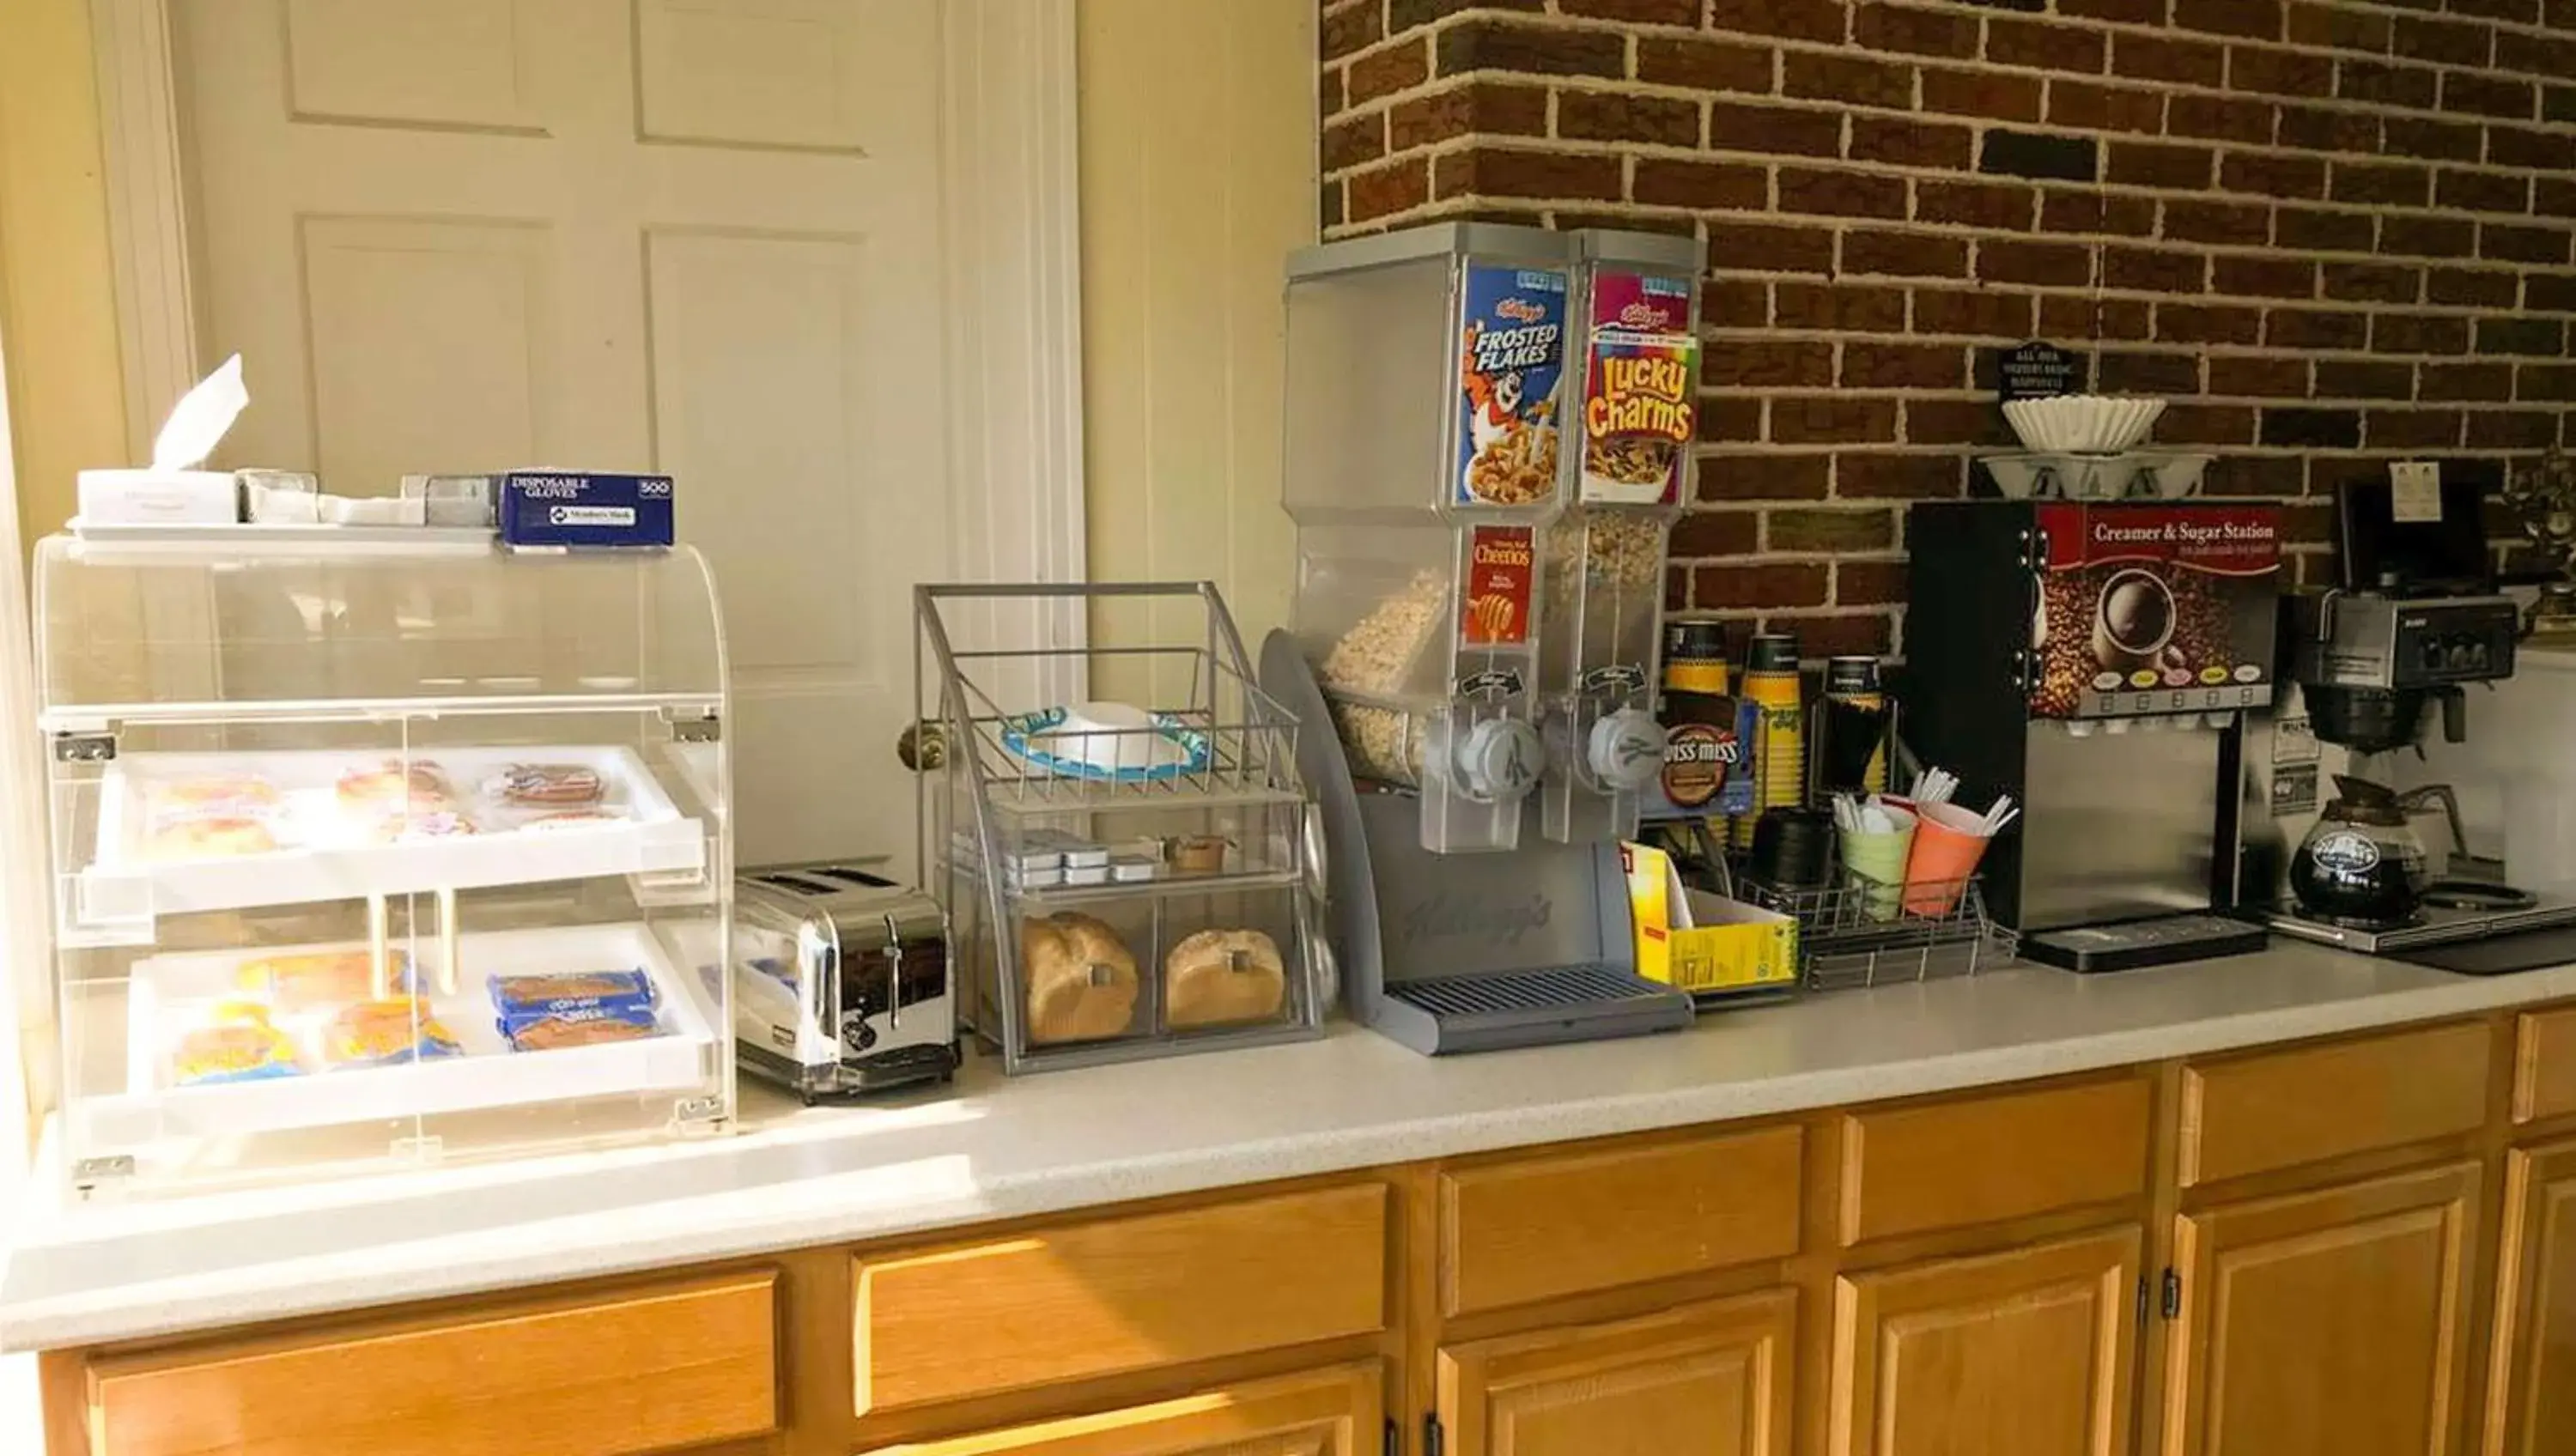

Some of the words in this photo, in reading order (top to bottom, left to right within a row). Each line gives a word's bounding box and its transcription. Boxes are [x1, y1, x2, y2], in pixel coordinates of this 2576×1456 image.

[1474, 324, 1558, 353] FROSTED
[1476, 343, 1549, 371] FLAKES
[1603, 356, 1688, 403] Lucky
[1588, 395, 1692, 441] Charms
[512, 476, 590, 488] DISPOSABLE
[525, 488, 578, 499] GLOVES
[641, 482, 671, 494] 500
[2095, 522, 2162, 543] Creamer
[2163, 521, 2177, 541] &
[2178, 520, 2222, 546] Sugar
[2223, 519, 2275, 540] Station
[1473, 543, 1530, 567] Cheerios
